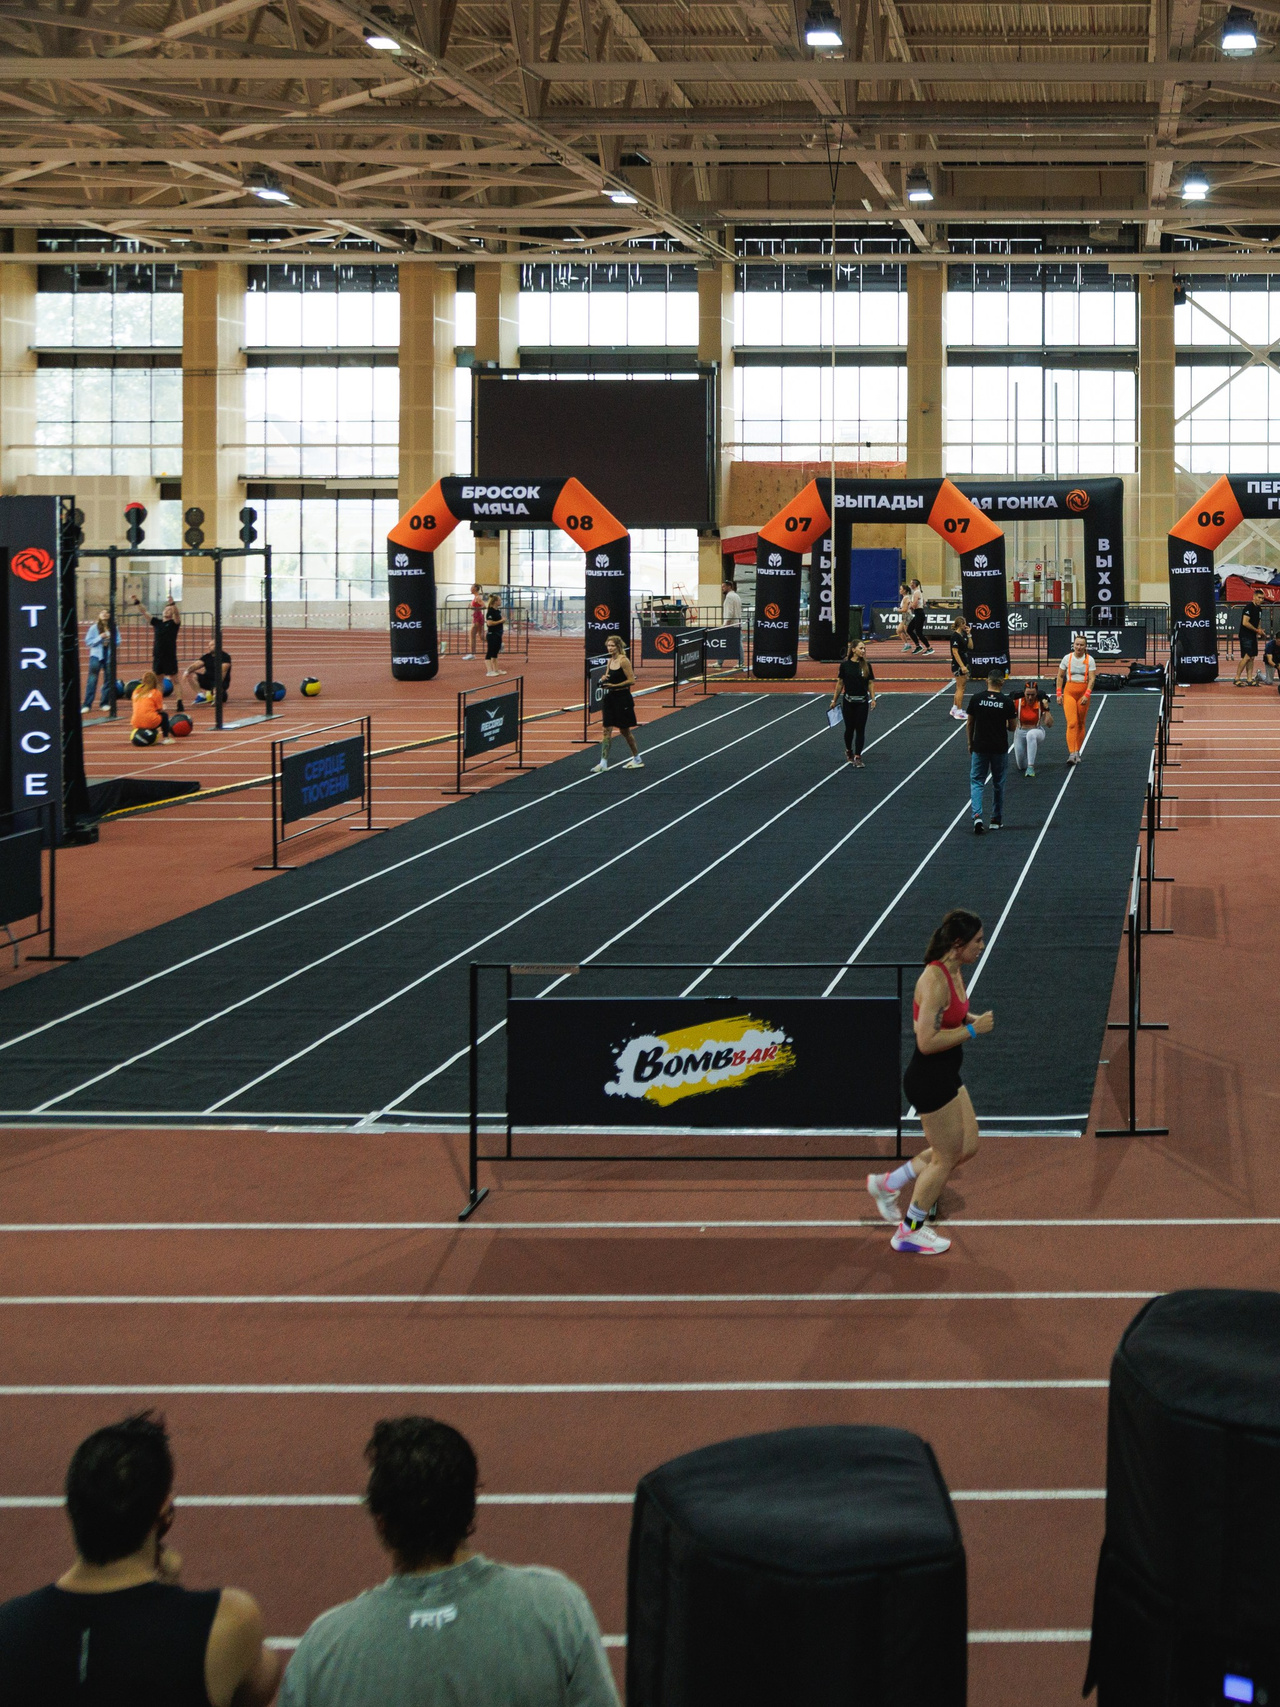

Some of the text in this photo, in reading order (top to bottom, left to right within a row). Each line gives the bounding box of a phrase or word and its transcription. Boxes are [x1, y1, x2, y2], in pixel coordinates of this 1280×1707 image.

[461, 486, 541, 499] БРОСОК
[473, 503, 530, 515] МЯЧА
[834, 495, 924, 510] ВЫПАДЫ
[998, 496, 1058, 509] ГОНКА
[409, 515, 437, 530] 08
[566, 515, 593, 530] 08
[785, 517, 812, 532] 07
[944, 518, 970, 533] 07
[1198, 511, 1225, 527] 06
[757, 568, 797, 576] YOUSTEEL
[962, 569, 1002, 577] YOUSTEEL
[1171, 566, 1211, 574] YOUSTEEL
[1096, 539, 1113, 621] ВЫХОД
[390, 621, 422, 629] T-RACE
[588, 622, 620, 630] T-RACE
[757, 620, 789, 629] T-RACE
[1177, 620, 1210, 628] T-RACE
[979, 700, 1004, 709] JUDGE
[480, 716, 504, 732] RECORD
[304, 753, 346, 781] СЕРДЦЕ
